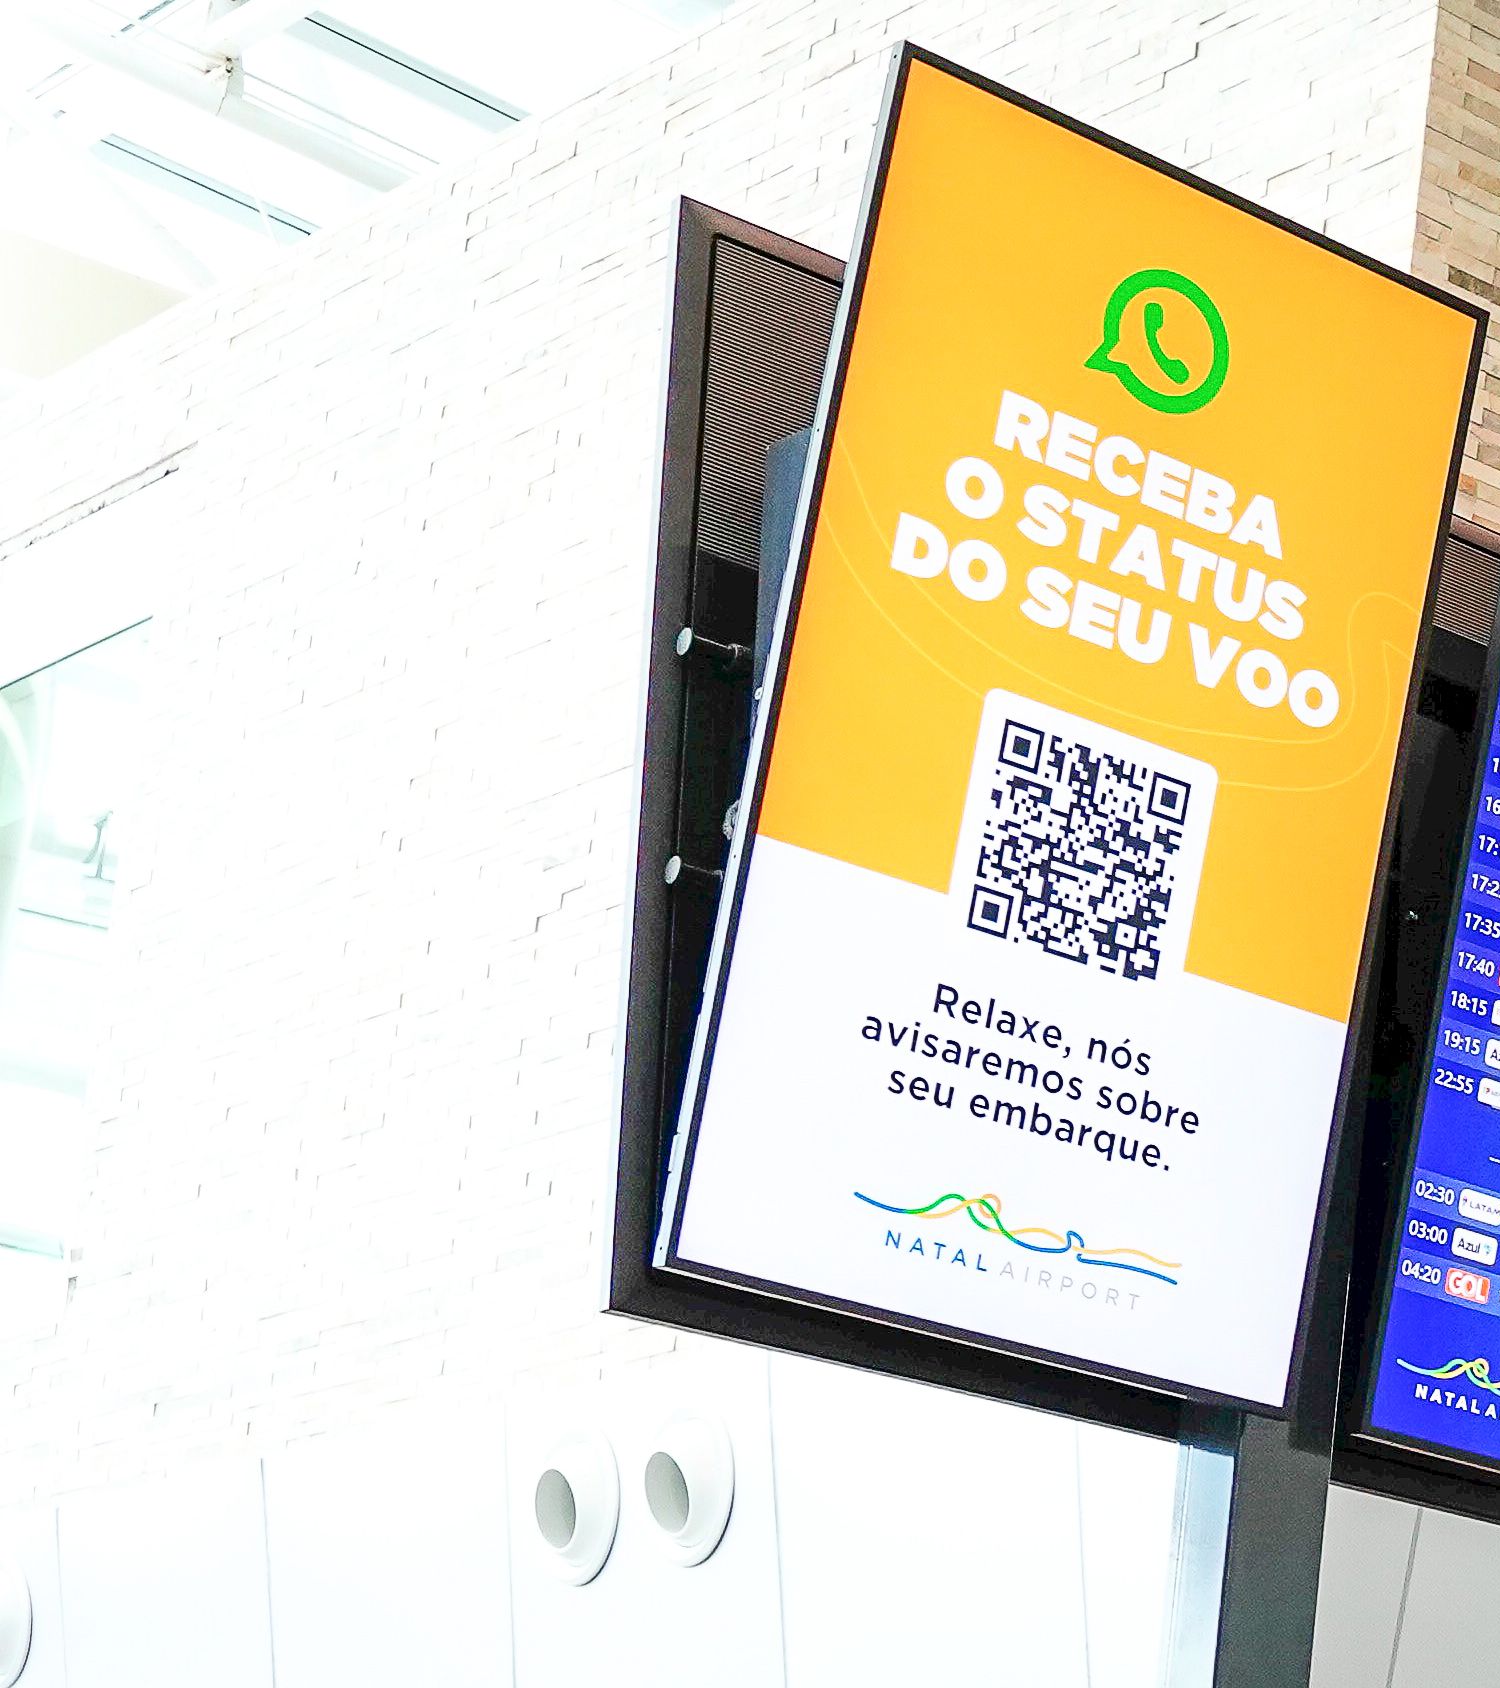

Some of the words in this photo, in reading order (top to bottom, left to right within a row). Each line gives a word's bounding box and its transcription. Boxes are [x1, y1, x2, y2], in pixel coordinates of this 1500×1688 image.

[993, 389, 1283, 560] RECEBA
[944, 455, 1005, 520] O
[1015, 483, 1307, 640] STATUS
[889, 511, 1007, 602] DO
[1019, 565, 1173, 665] SEU
[1188, 621, 1340, 728] VOO
[1464, 912, 1500, 939] 17:35
[1458, 951, 1495, 977] 17:40
[1451, 990, 1488, 1016] 18:15
[933, 983, 1071, 1059] Relaxe,
[1087, 1037, 1151, 1076] nós
[1444, 1029, 1480, 1055] 19:15
[861, 1015, 1083, 1100] avisaremos
[1096, 1085, 1199, 1134] sobre
[1434, 1068, 1474, 1094] 22:55
[887, 1070, 955, 1109] seu
[969, 1094, 1169, 1171] embarque.
[1415, 1179, 1455, 1206] 02:30
[1408, 1219, 1448, 1245] 03:00
[884, 1230, 987, 1272] NATAL
[999, 1260, 1140, 1310] AIRPORT
[1401, 1259, 1441, 1284] 04:20
[1446, 1271, 1491, 1304] GOL
